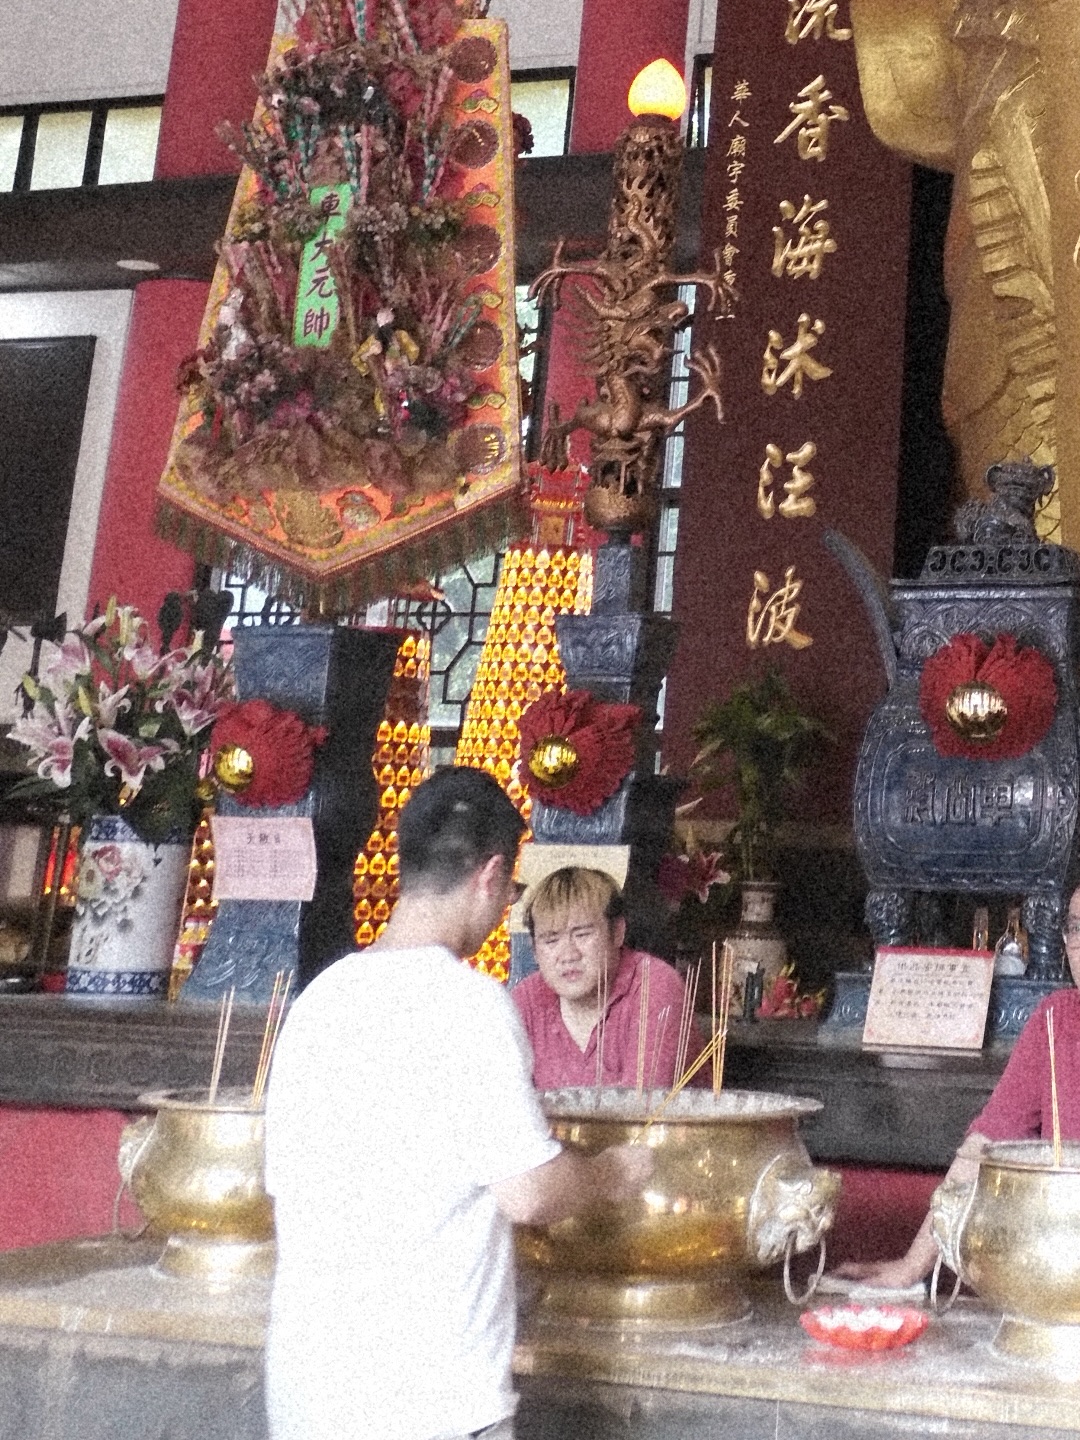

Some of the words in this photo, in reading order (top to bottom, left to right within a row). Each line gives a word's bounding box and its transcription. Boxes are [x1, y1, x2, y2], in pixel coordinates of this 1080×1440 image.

[304, 193, 341, 339] 車大元帥
[715, 79, 752, 321] 華人廟宇委員會
